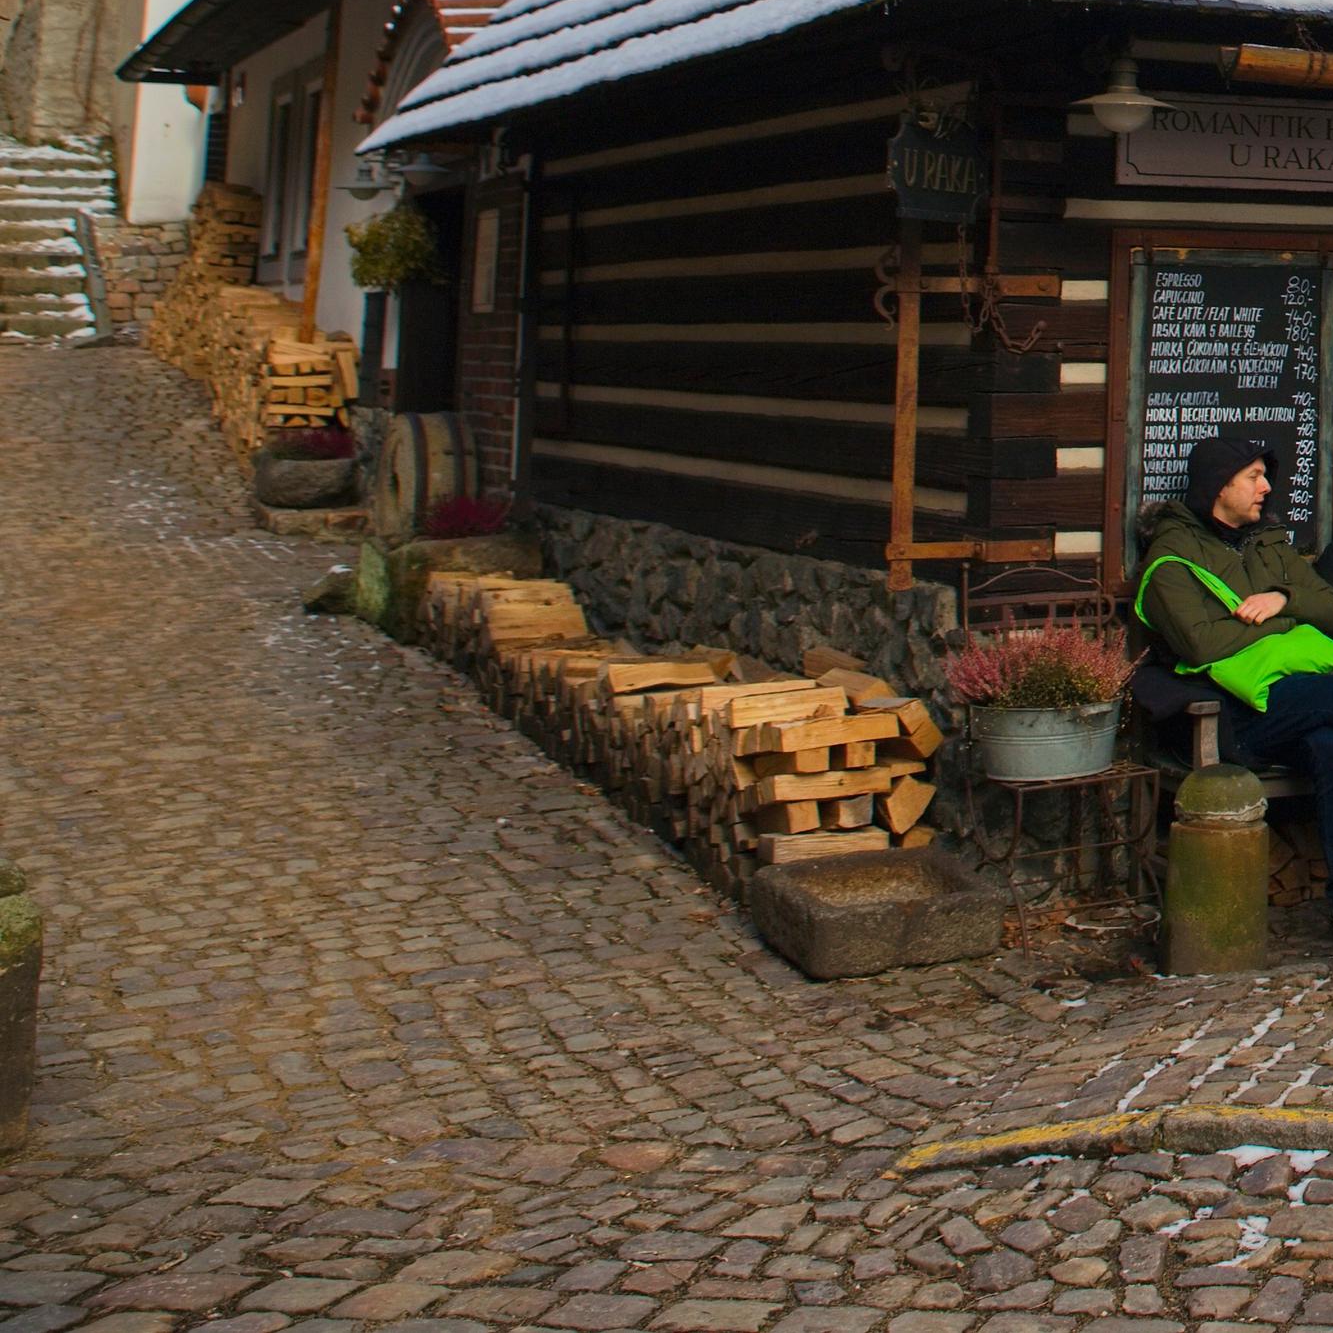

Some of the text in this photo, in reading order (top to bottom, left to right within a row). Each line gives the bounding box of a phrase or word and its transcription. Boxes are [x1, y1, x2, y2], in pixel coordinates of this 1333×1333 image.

[1153, 109, 1313, 139] ROMANTIK
[1229, 144, 1251, 167] U
[904, 148, 976, 194] U RAKA
[1155, 272, 1202, 288] ESPRESSO
[1153, 290, 1205, 304] CAPUCCINO
[1233, 307, 1264, 322] WHITE
[1152, 321, 1181, 337] IRSKÁ
[1183, 321, 1207, 338] KÁVA
[1210, 325, 1215, 338] S
[1219, 324, 1256, 338] BAILEYS
[1151, 339, 1184, 357] HORKÁ
[1187, 339, 1228, 356] ČOKOLÁDA
[1231, 342, 1242, 357] SE
[1149, 357, 1183, 374] HORKÁ
[1183, 356, 1227, 374] ČOKOLÁDA
[1230, 360, 1237, 374] S
[1146, 407, 1180, 422] HORKÁ
[1181, 407, 1242, 422] BECHEROVKA
[1145, 424, 1178, 441] HORKÁ
[1181, 423, 1219, 440] HRUŠKA
[1143, 441, 1178, 458] HORKÁ
[1143, 475, 1189, 491] PROSECCO
